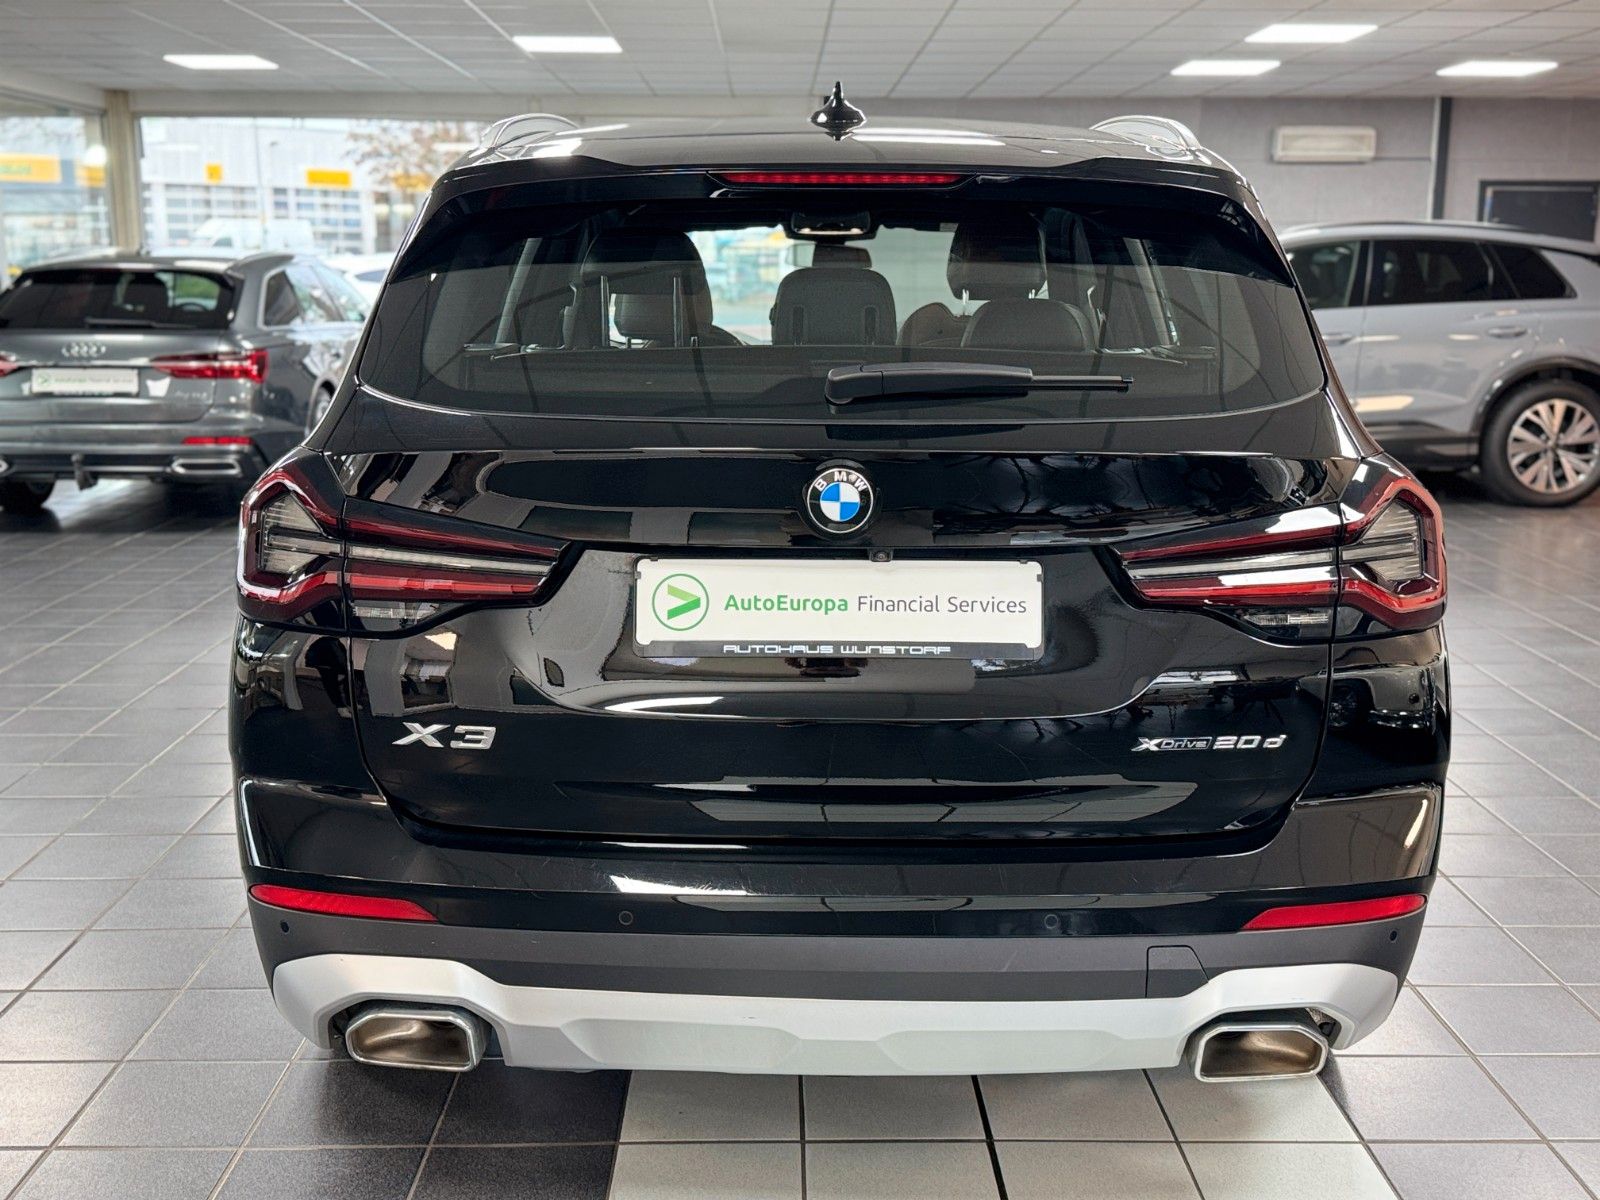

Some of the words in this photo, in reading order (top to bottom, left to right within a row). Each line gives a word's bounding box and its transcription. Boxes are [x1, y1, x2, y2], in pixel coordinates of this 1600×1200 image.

[814, 470, 868, 492] BMW
[724, 594, 849, 616] AutoEuropa
[858, 595, 940, 613] Financial
[947, 596, 1027, 614] Services
[723, 645, 834, 654] AUTOHAUS
[840, 645, 951, 655] WUNSTORF
[391, 721, 497, 750] X3
